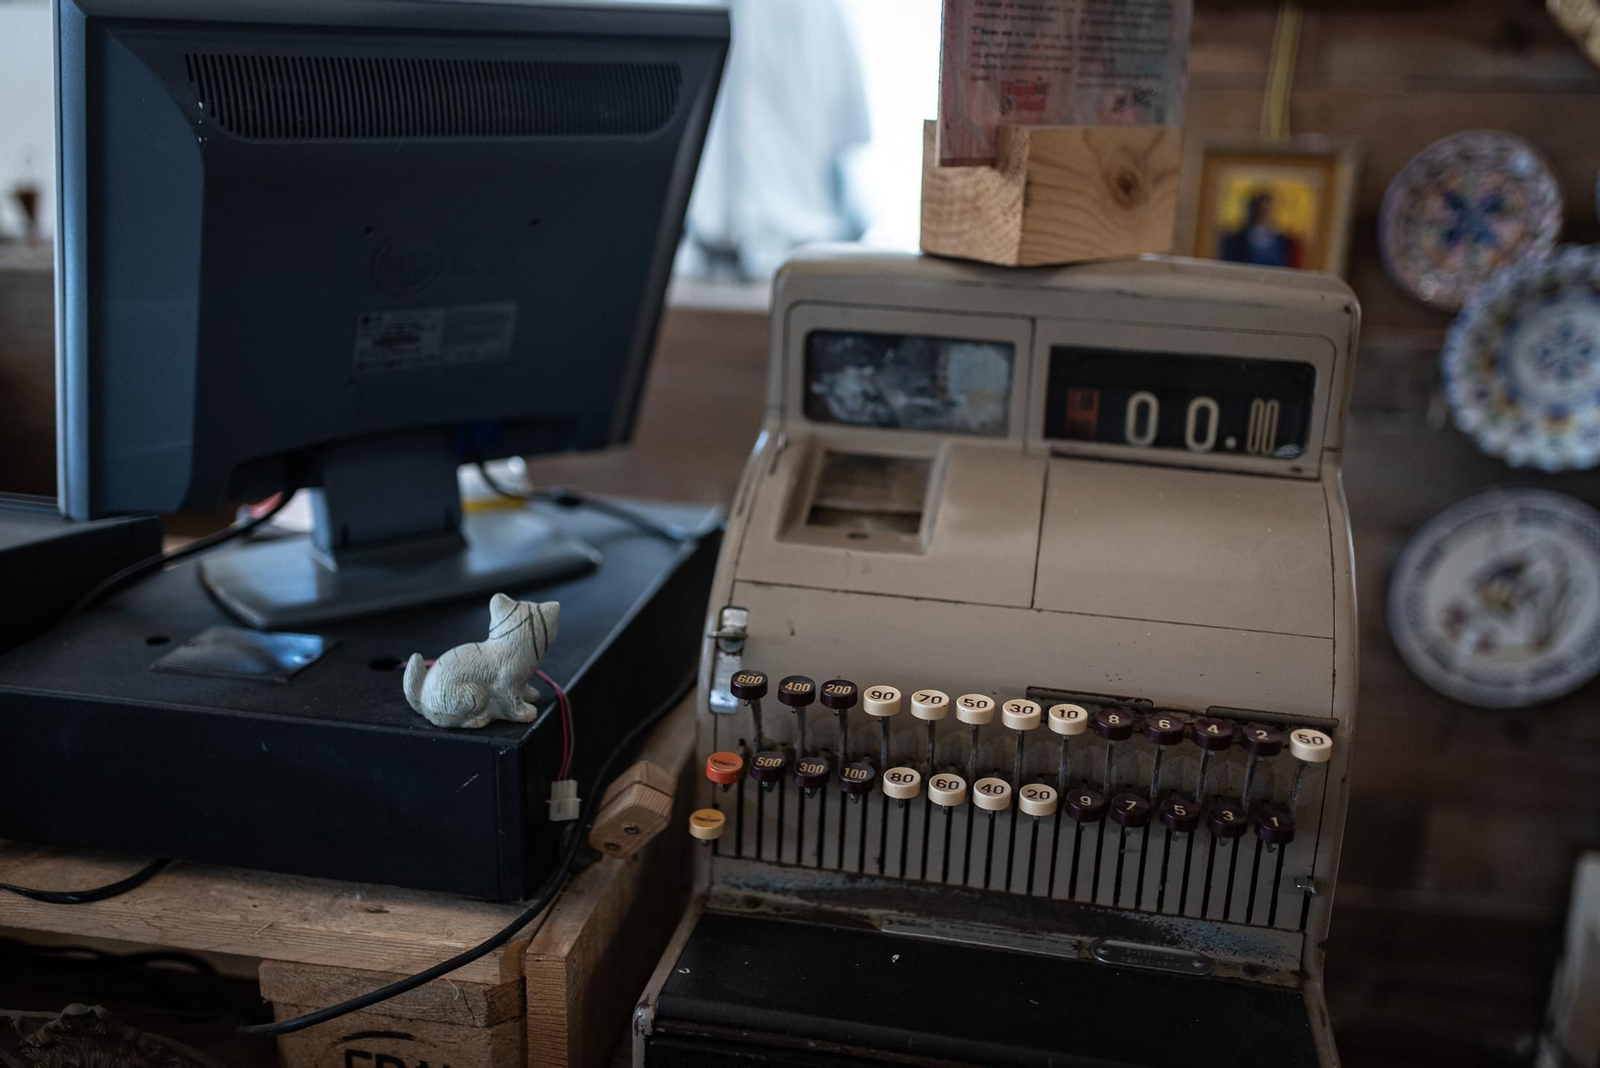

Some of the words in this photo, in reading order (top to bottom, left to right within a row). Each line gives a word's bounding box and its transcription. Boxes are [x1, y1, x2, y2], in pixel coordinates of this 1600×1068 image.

[738, 673, 763, 684] 600
[785, 681, 811, 692] 400
[825, 683, 852, 694] 200
[870, 690, 895, 701] 90
[918, 694, 943, 705] 70
[963, 698, 988, 709] 50
[1009, 704, 1034, 715] 30
[1058, 709, 1078, 719] 10
[1109, 714, 1120, 724] 8
[1158, 719, 1170, 730] 6
[1207, 724, 1218, 734] 4
[1256, 730, 1268, 741] 2
[1298, 733, 1324, 745] 50
[756, 757, 782, 767] 500
[799, 763, 824, 774] 300
[844, 768, 867, 779] 100
[891, 773, 914, 783] 80
[936, 780, 960, 791] 60
[980, 784, 1004, 795] 40
[1027, 789, 1050, 800] 20
[1080, 796, 1091, 807] 9
[1125, 800, 1137, 811] 7
[1174, 805, 1185, 816] 5
[1223, 811, 1234, 821] 3
[1270, 816, 1279, 827] 1
